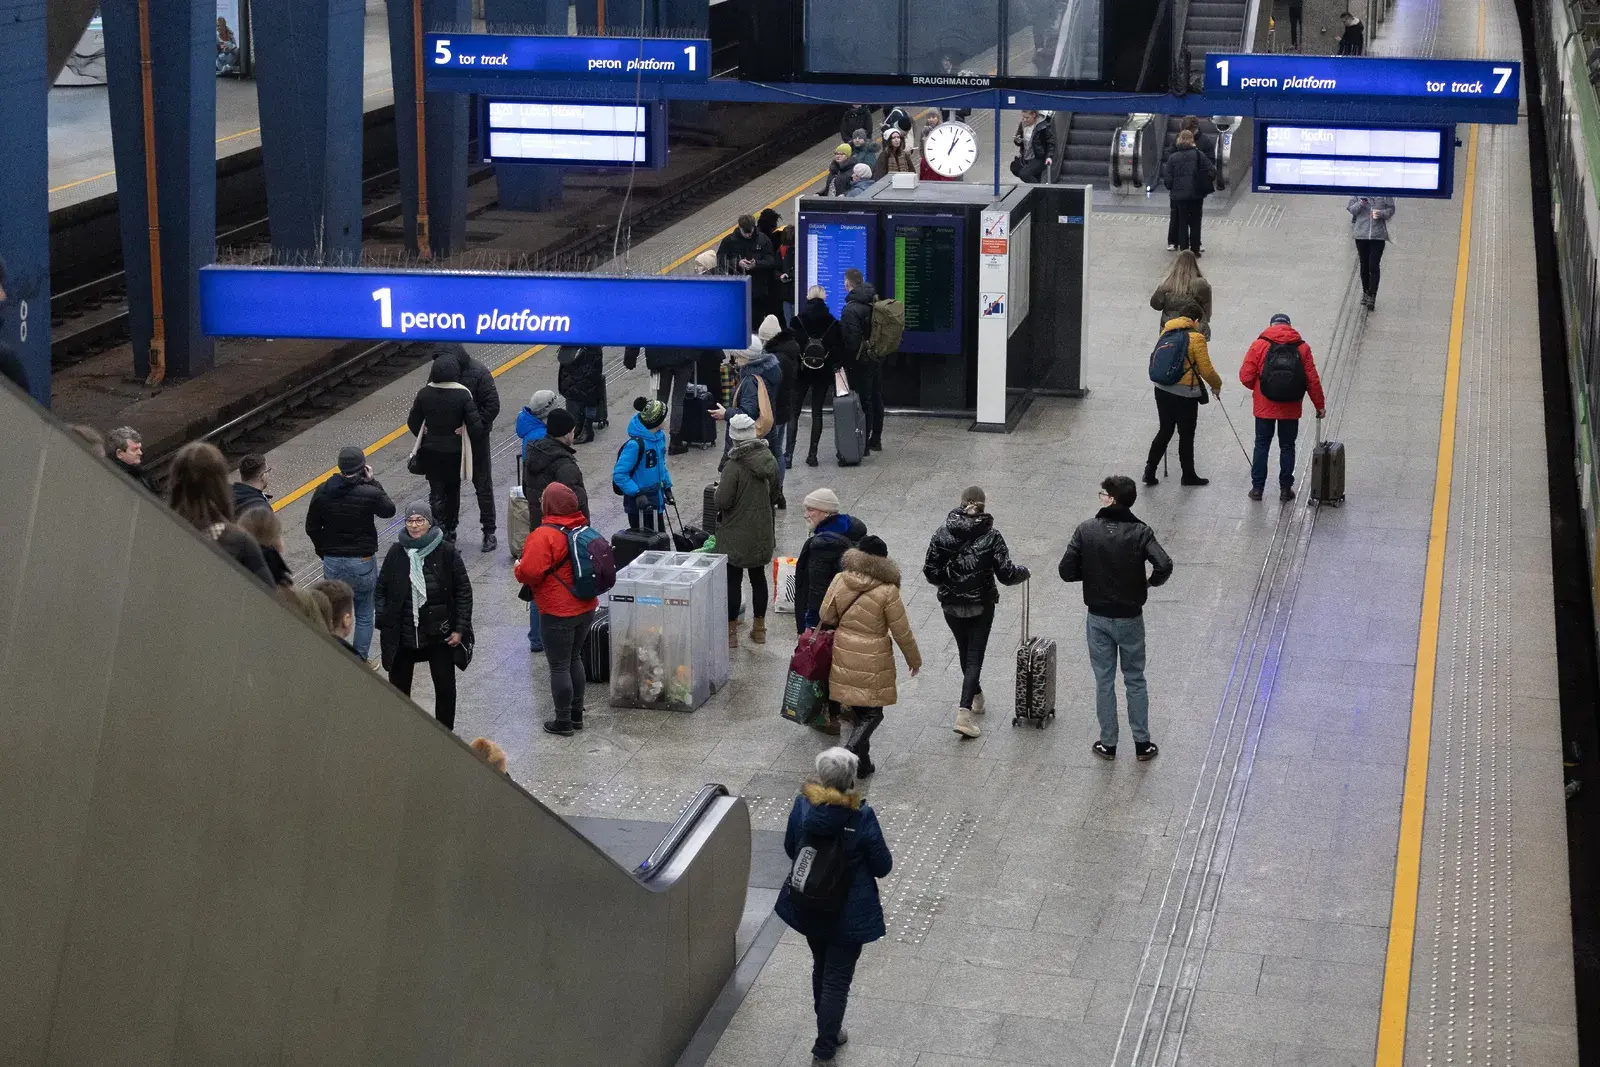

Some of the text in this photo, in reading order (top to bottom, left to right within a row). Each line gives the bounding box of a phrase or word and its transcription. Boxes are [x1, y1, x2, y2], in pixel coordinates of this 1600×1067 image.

[435, 40, 697, 72] 5 tor track peron platform 1
[912, 77, 990, 86] BRAUGHMAN.COM
[1216, 60, 1512, 94] 1 peron platform tor track 7
[372, 287, 570, 334] 1 peron platform
[646, 449, 657, 468] B
[797, 850, 814, 877] COOPER
